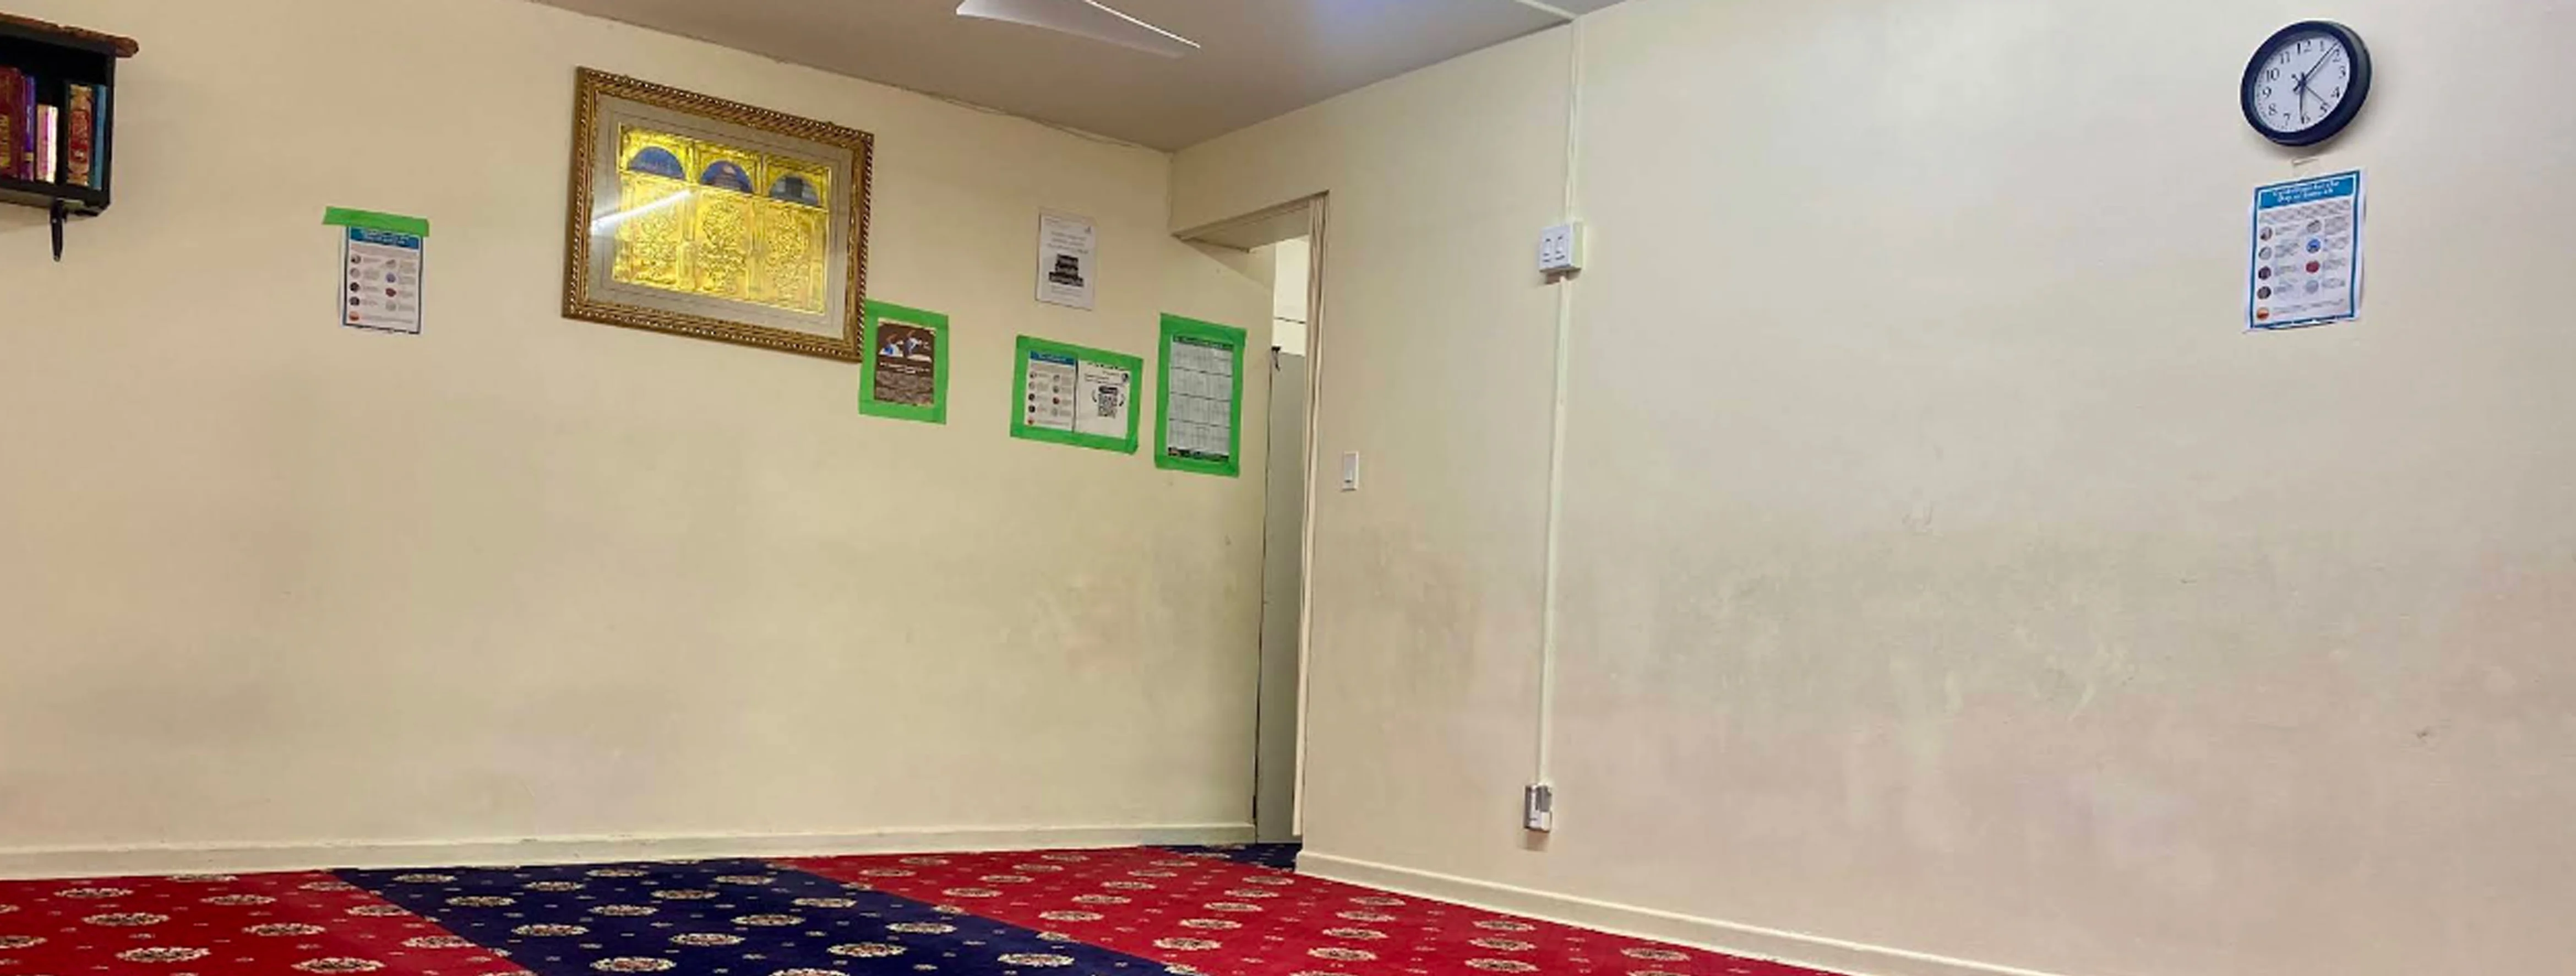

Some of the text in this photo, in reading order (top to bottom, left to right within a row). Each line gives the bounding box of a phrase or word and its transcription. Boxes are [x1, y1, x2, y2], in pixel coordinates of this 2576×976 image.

[2296, 40, 2311, 55] 12
[2320, 40, 2324, 51] 1
[2279, 51, 2290, 64] 11
[2332, 48, 2342, 63] 2
[2266, 67, 2280, 82] 10
[2339, 66, 2346, 79] 3
[2262, 86, 2272, 98] 9
[2330, 86, 2340, 98] 4
[2268, 103, 2277, 116] 8
[2318, 102, 2329, 117] 5
[2284, 112, 2291, 126] 7
